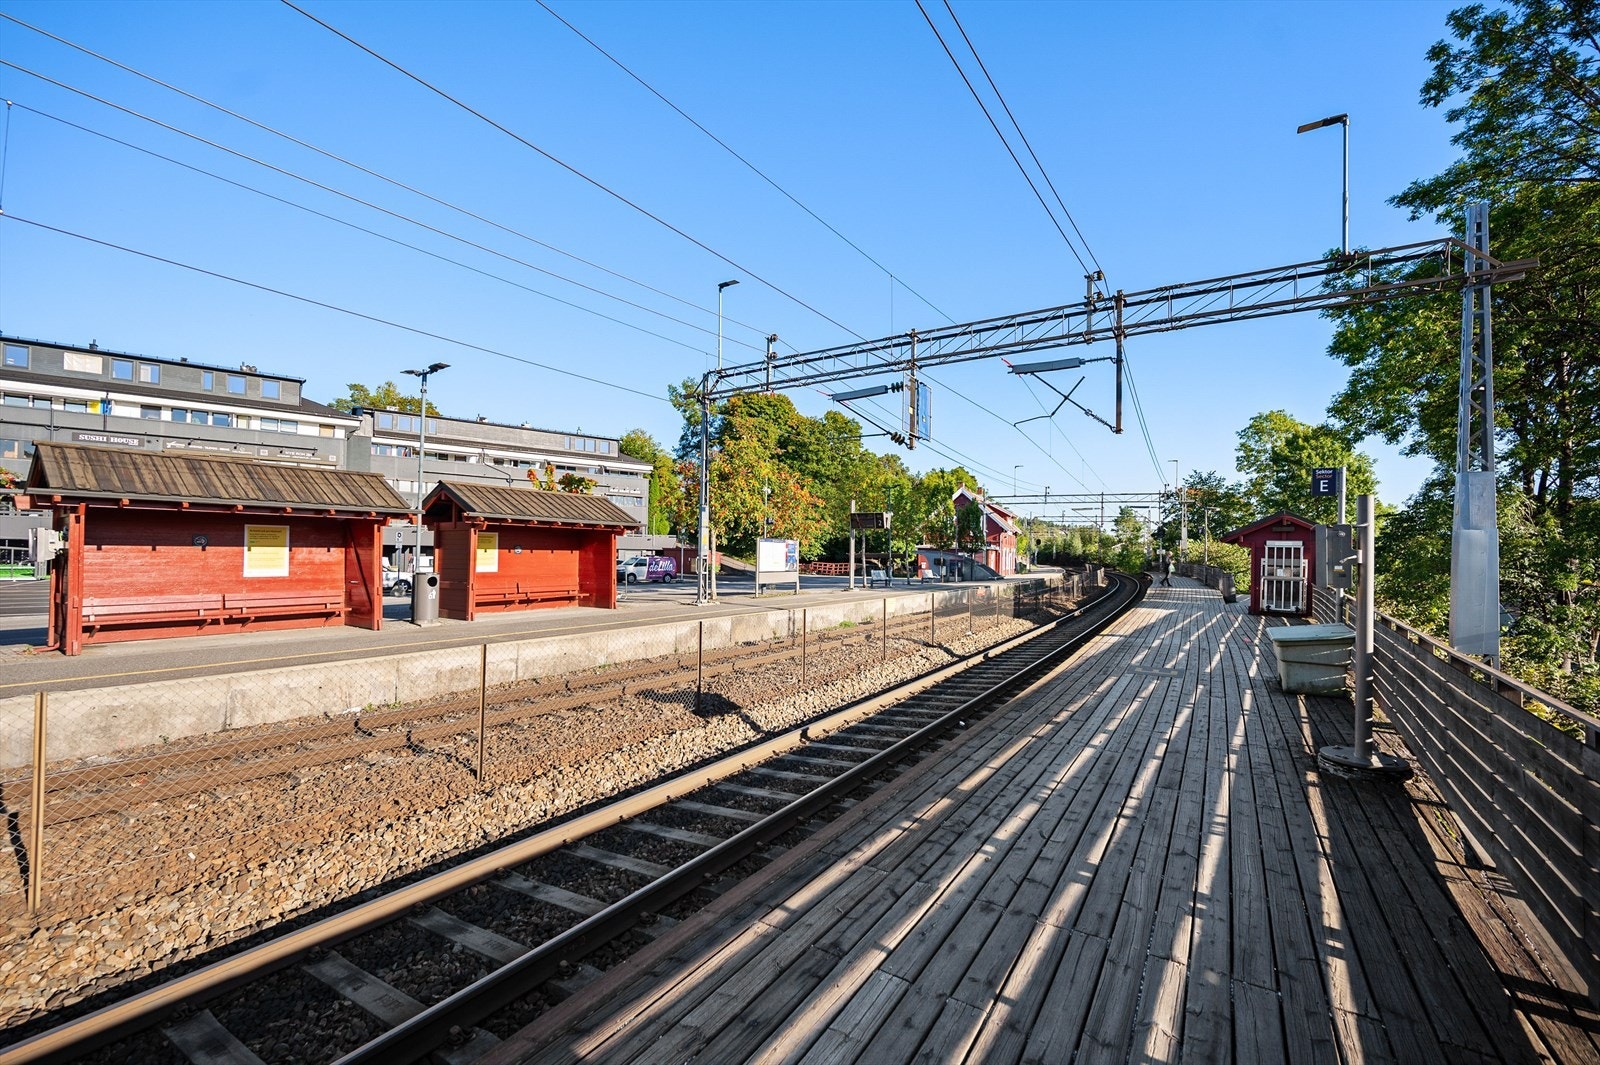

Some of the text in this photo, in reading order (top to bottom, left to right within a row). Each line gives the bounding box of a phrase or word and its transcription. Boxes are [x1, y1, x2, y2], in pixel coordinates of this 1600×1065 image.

[79, 434, 139, 446] SUSHI HOUSE
[1320, 480, 1329, 492] E
